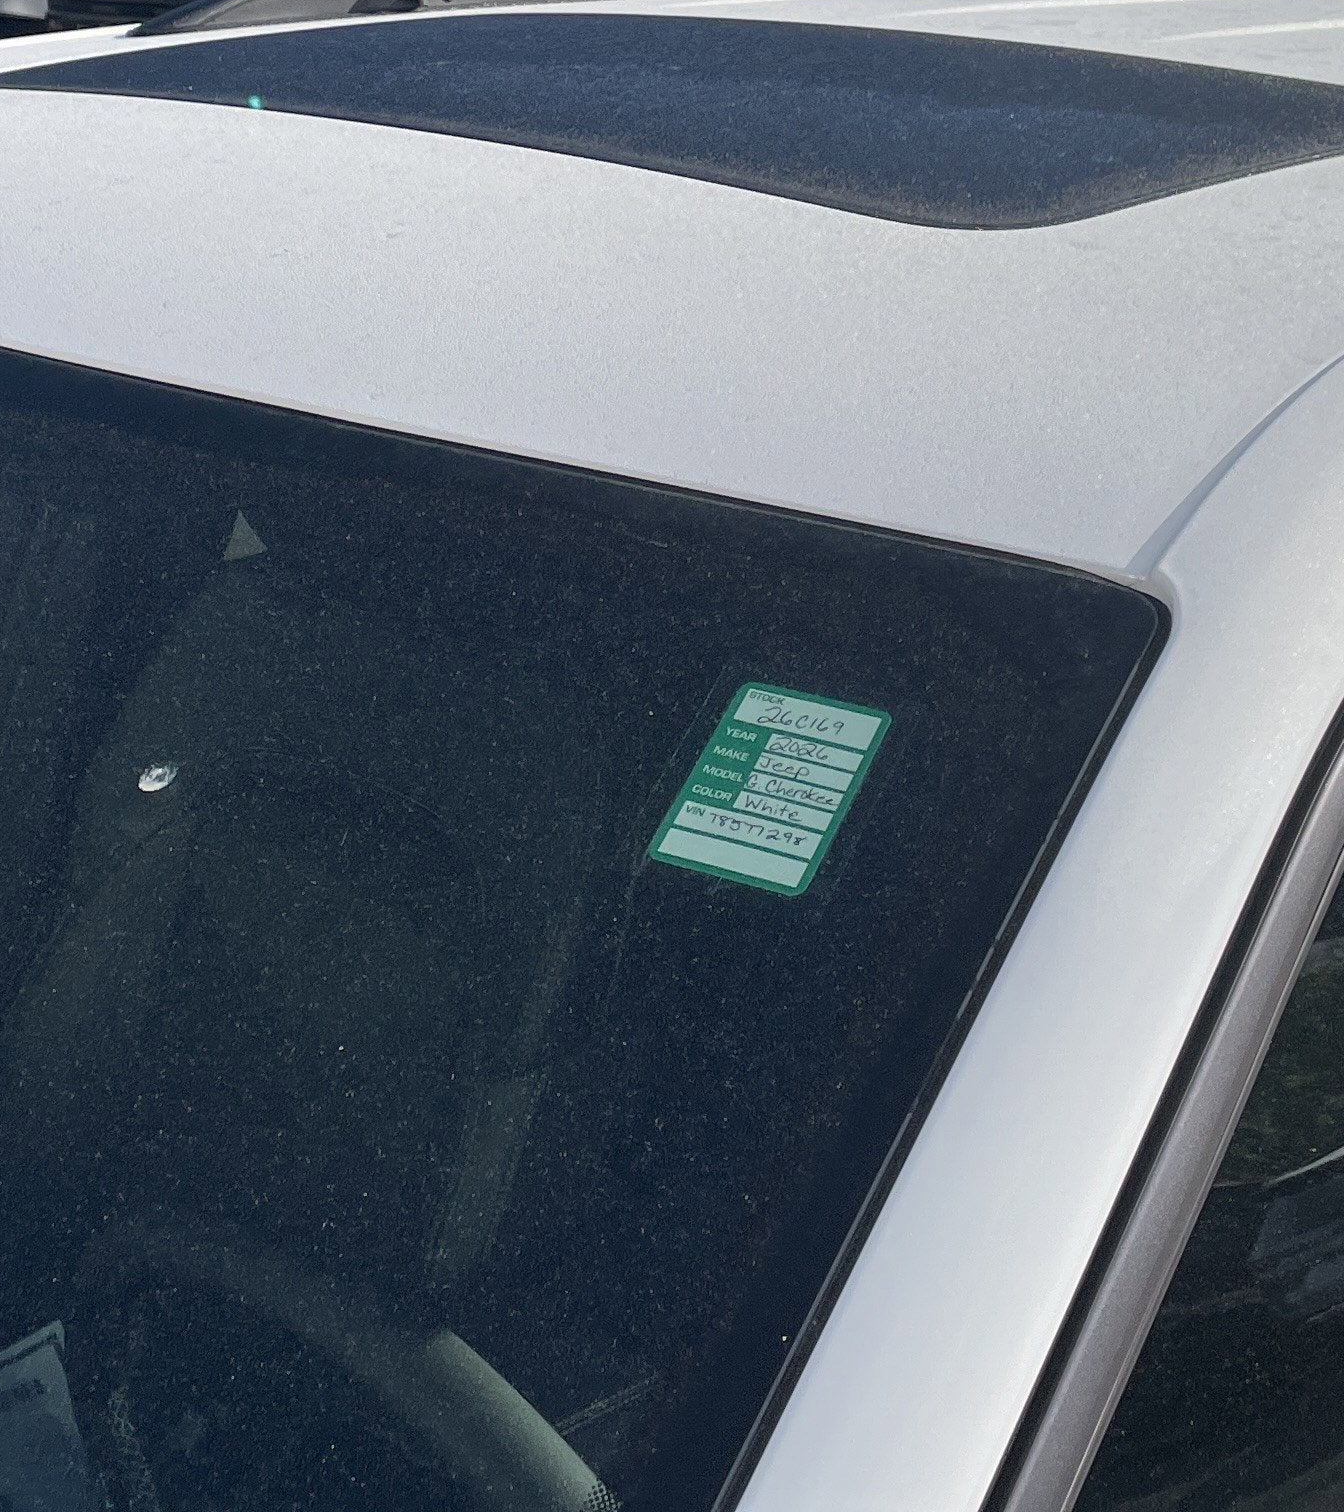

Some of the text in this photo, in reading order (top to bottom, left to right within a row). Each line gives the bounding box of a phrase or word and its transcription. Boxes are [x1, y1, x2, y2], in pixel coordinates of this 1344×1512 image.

[749, 690, 787, 706] STOCK
[757, 705, 845, 736] 26C169
[726, 726, 830, 761] YEAR 2026
[713, 745, 811, 779] MAKE Jeep
[702, 764, 745, 783] MODEL
[765, 778, 838, 806] Cherokee
[686, 804, 706, 817] VIN
[691, 784, 803, 822] COLOR White
